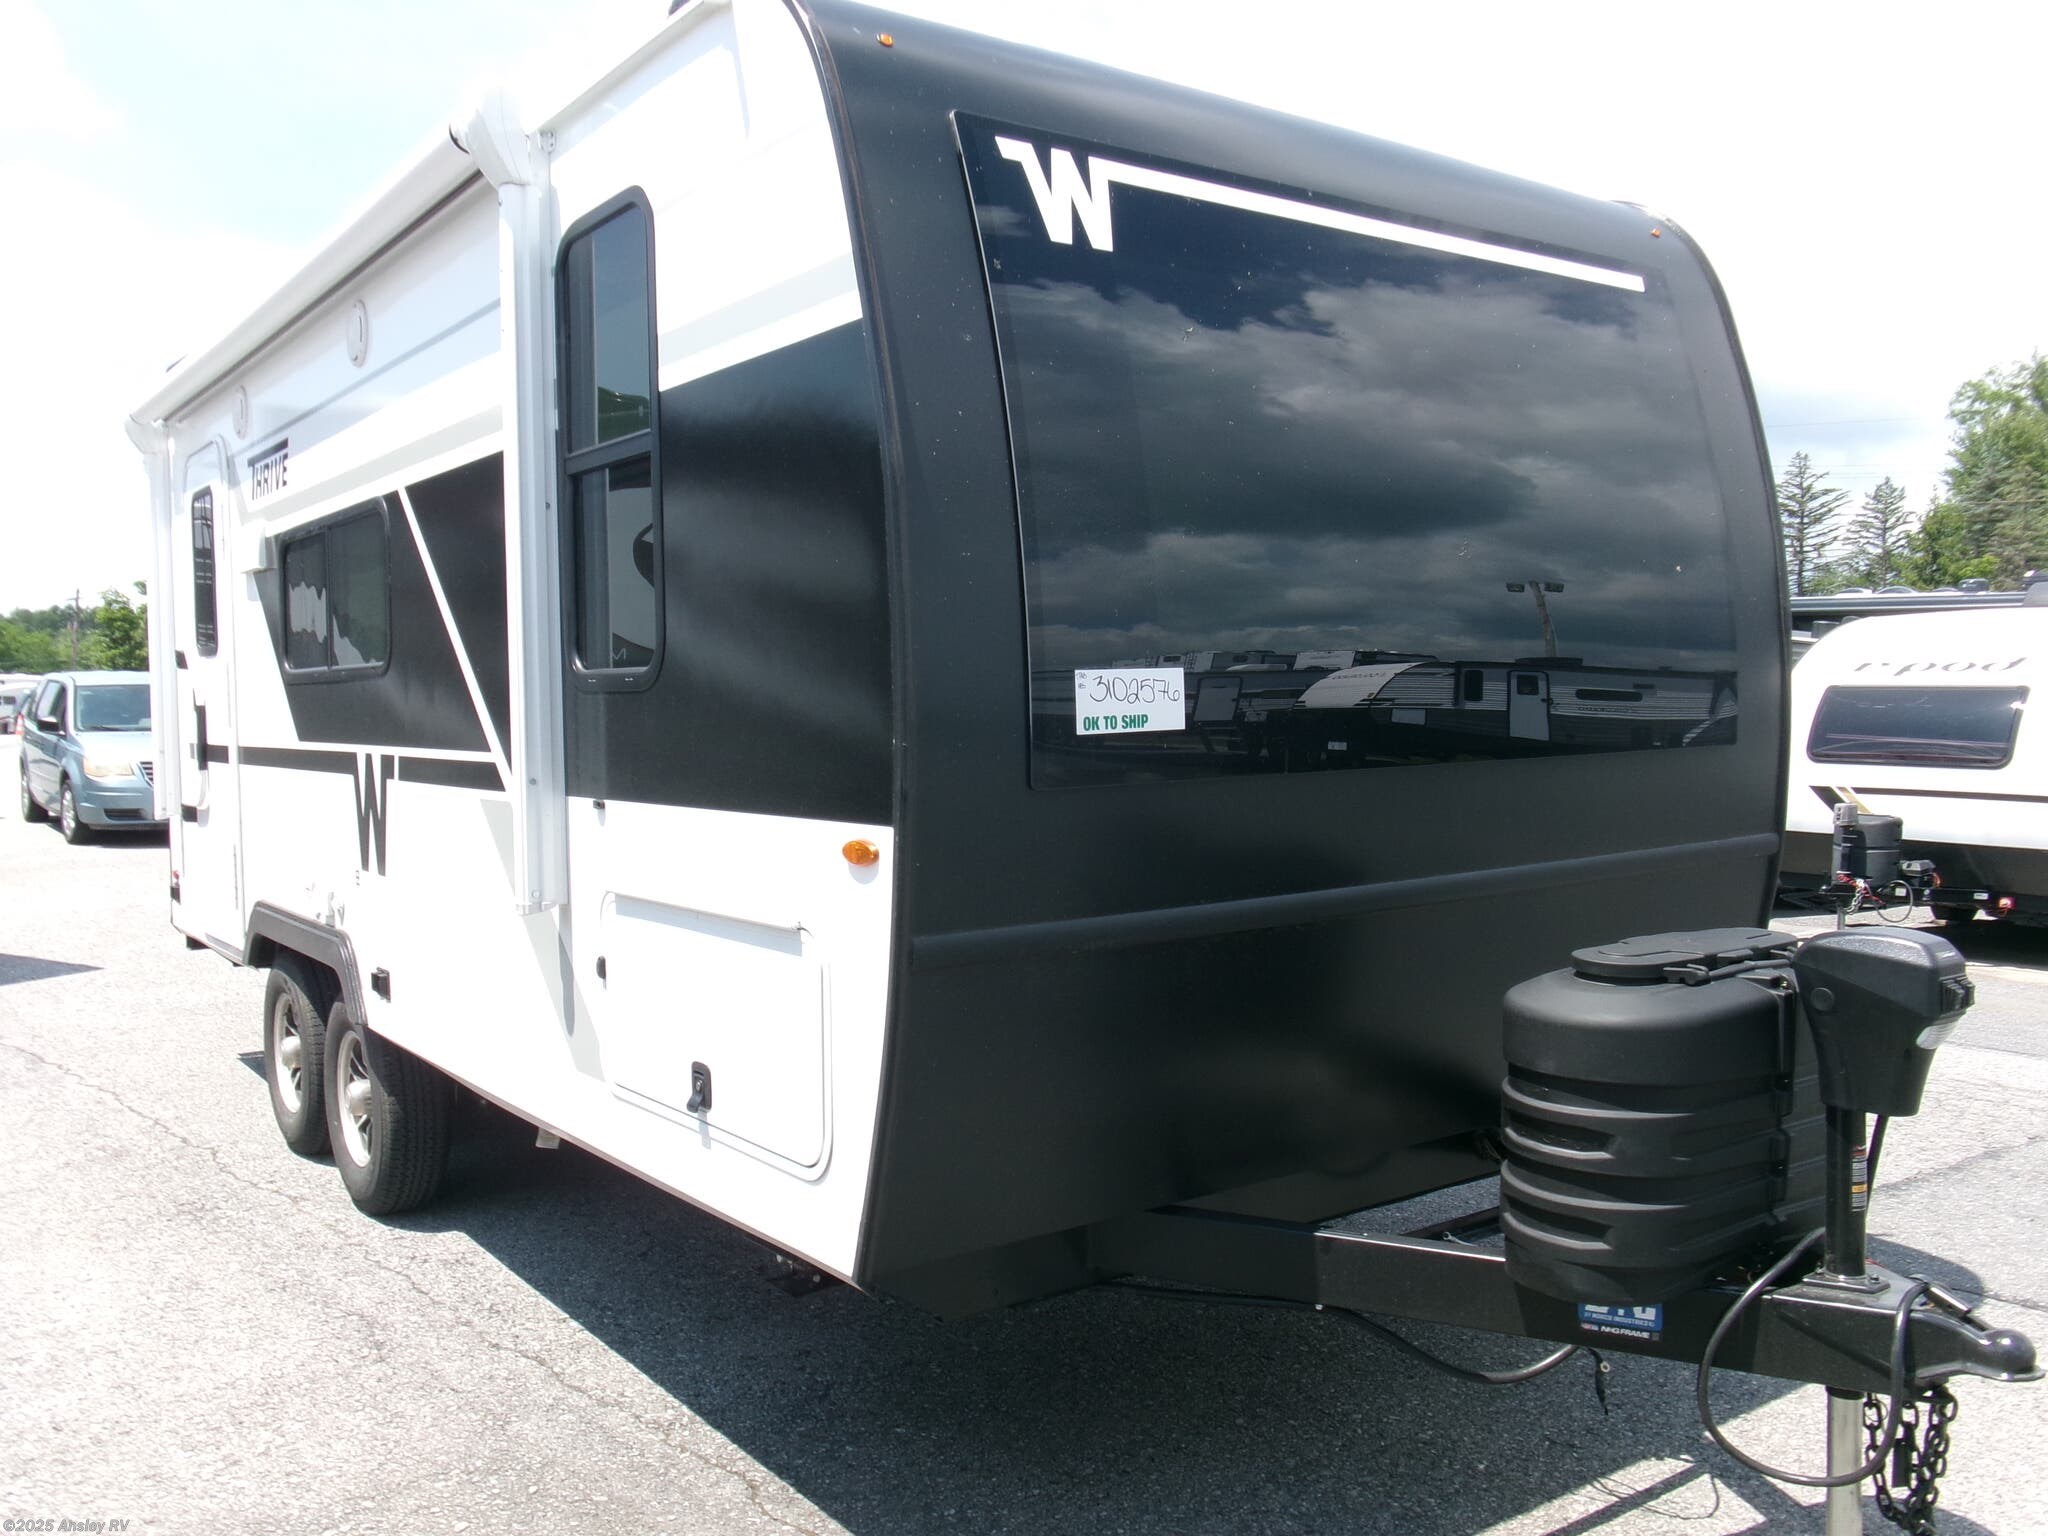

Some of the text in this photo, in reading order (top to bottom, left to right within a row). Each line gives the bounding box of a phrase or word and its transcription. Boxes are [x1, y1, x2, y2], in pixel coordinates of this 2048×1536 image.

[247, 437, 288, 501] THRIVE
[1089, 675, 1181, 704] 3102576
[1083, 714, 1149, 731] OK TO SHIP
